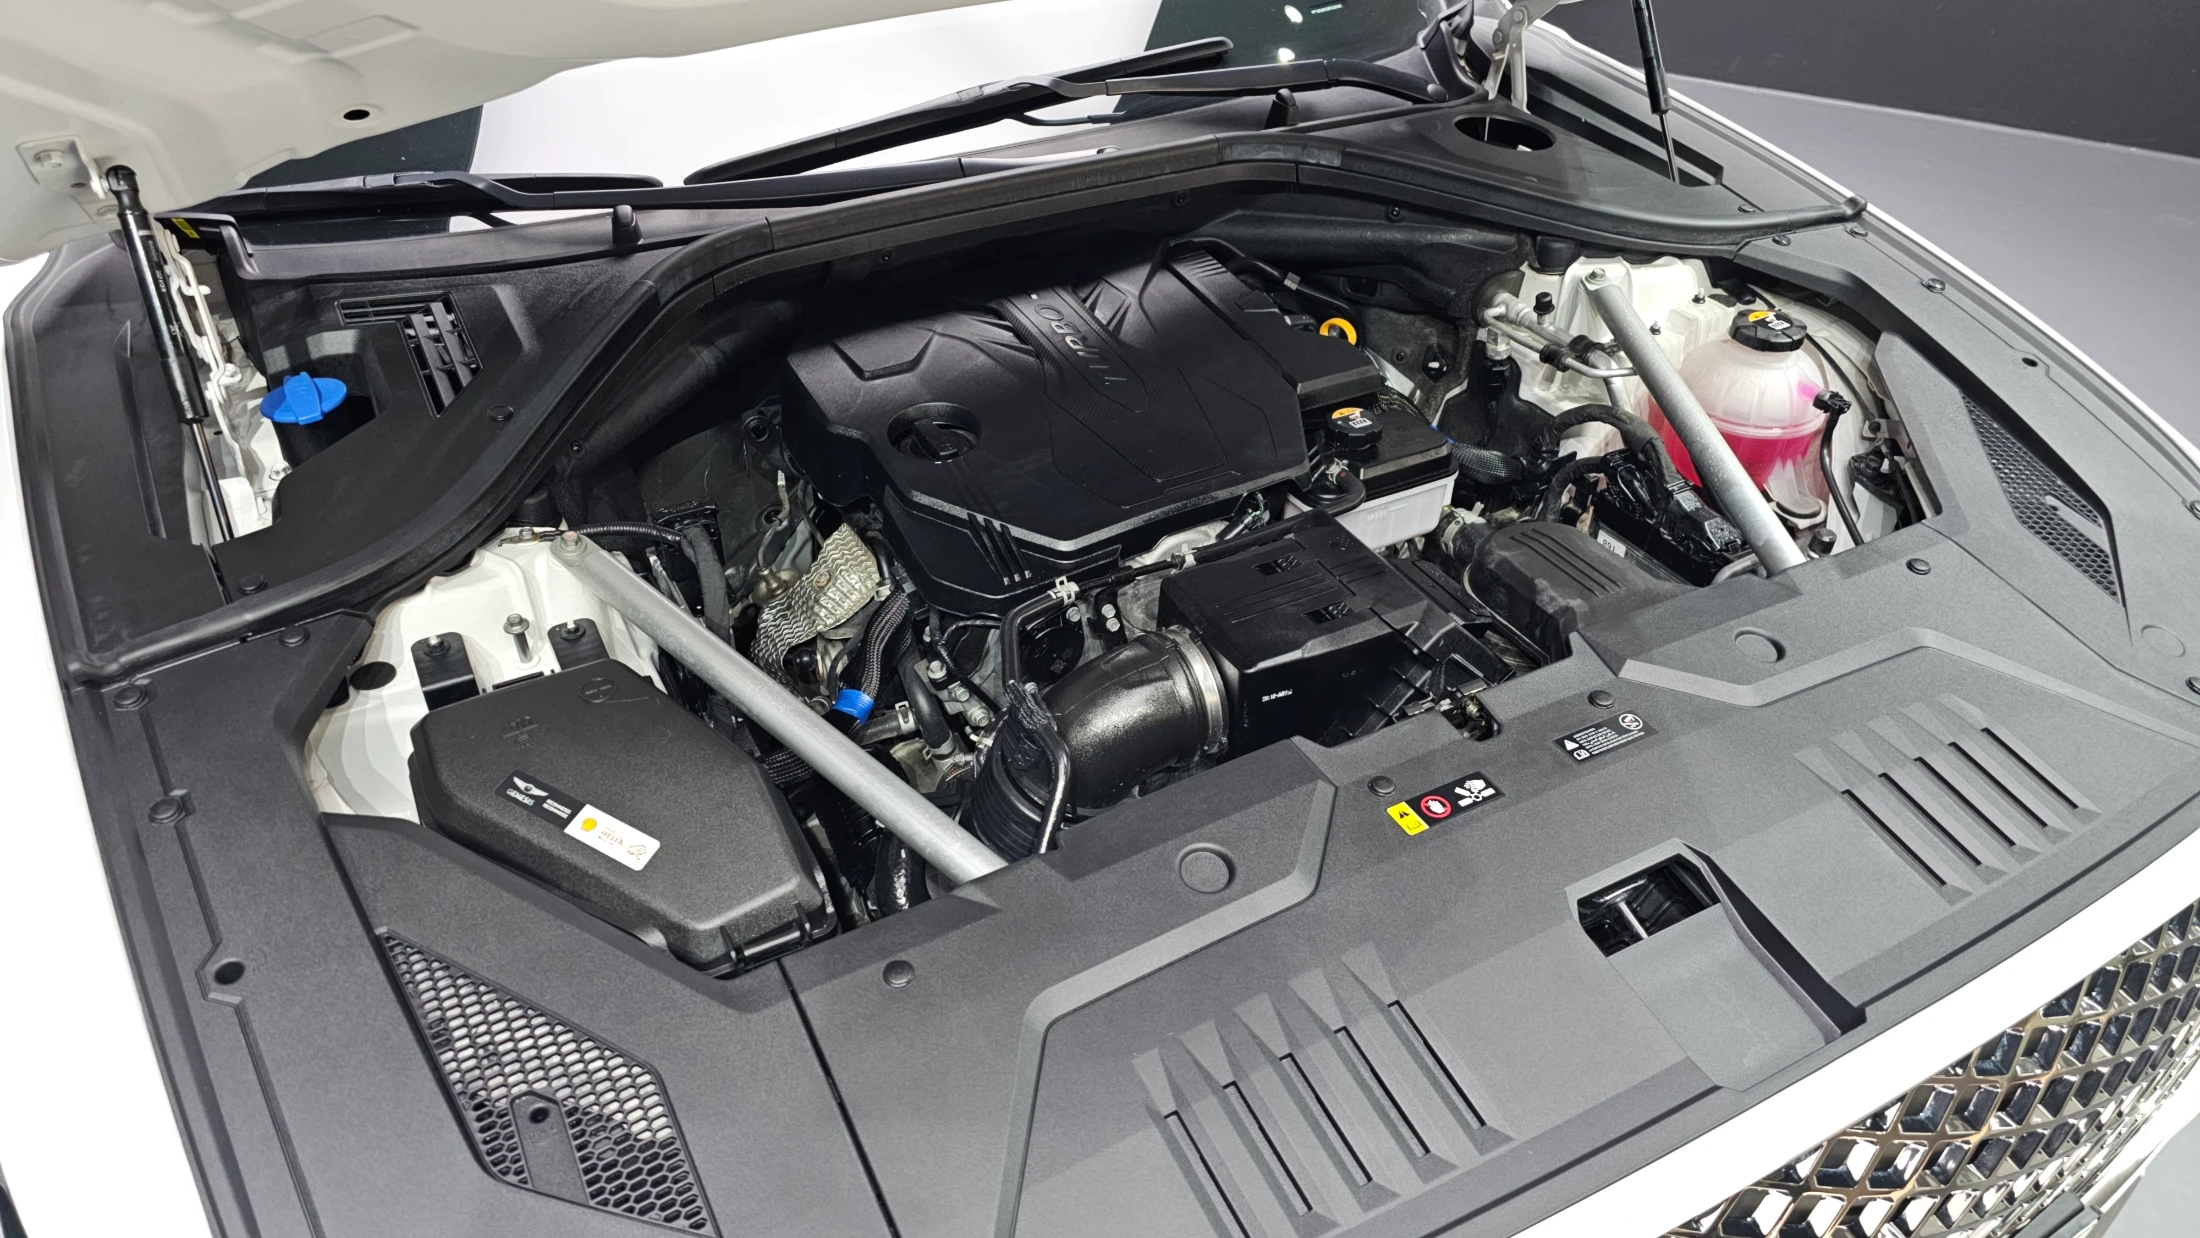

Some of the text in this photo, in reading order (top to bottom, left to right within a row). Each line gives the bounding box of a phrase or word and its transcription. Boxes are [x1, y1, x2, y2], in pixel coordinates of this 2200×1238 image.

[1034, 303, 1127, 385] TURBO
[506, 788, 535, 806] GENESIS
[600, 830, 624, 846] HELIX
